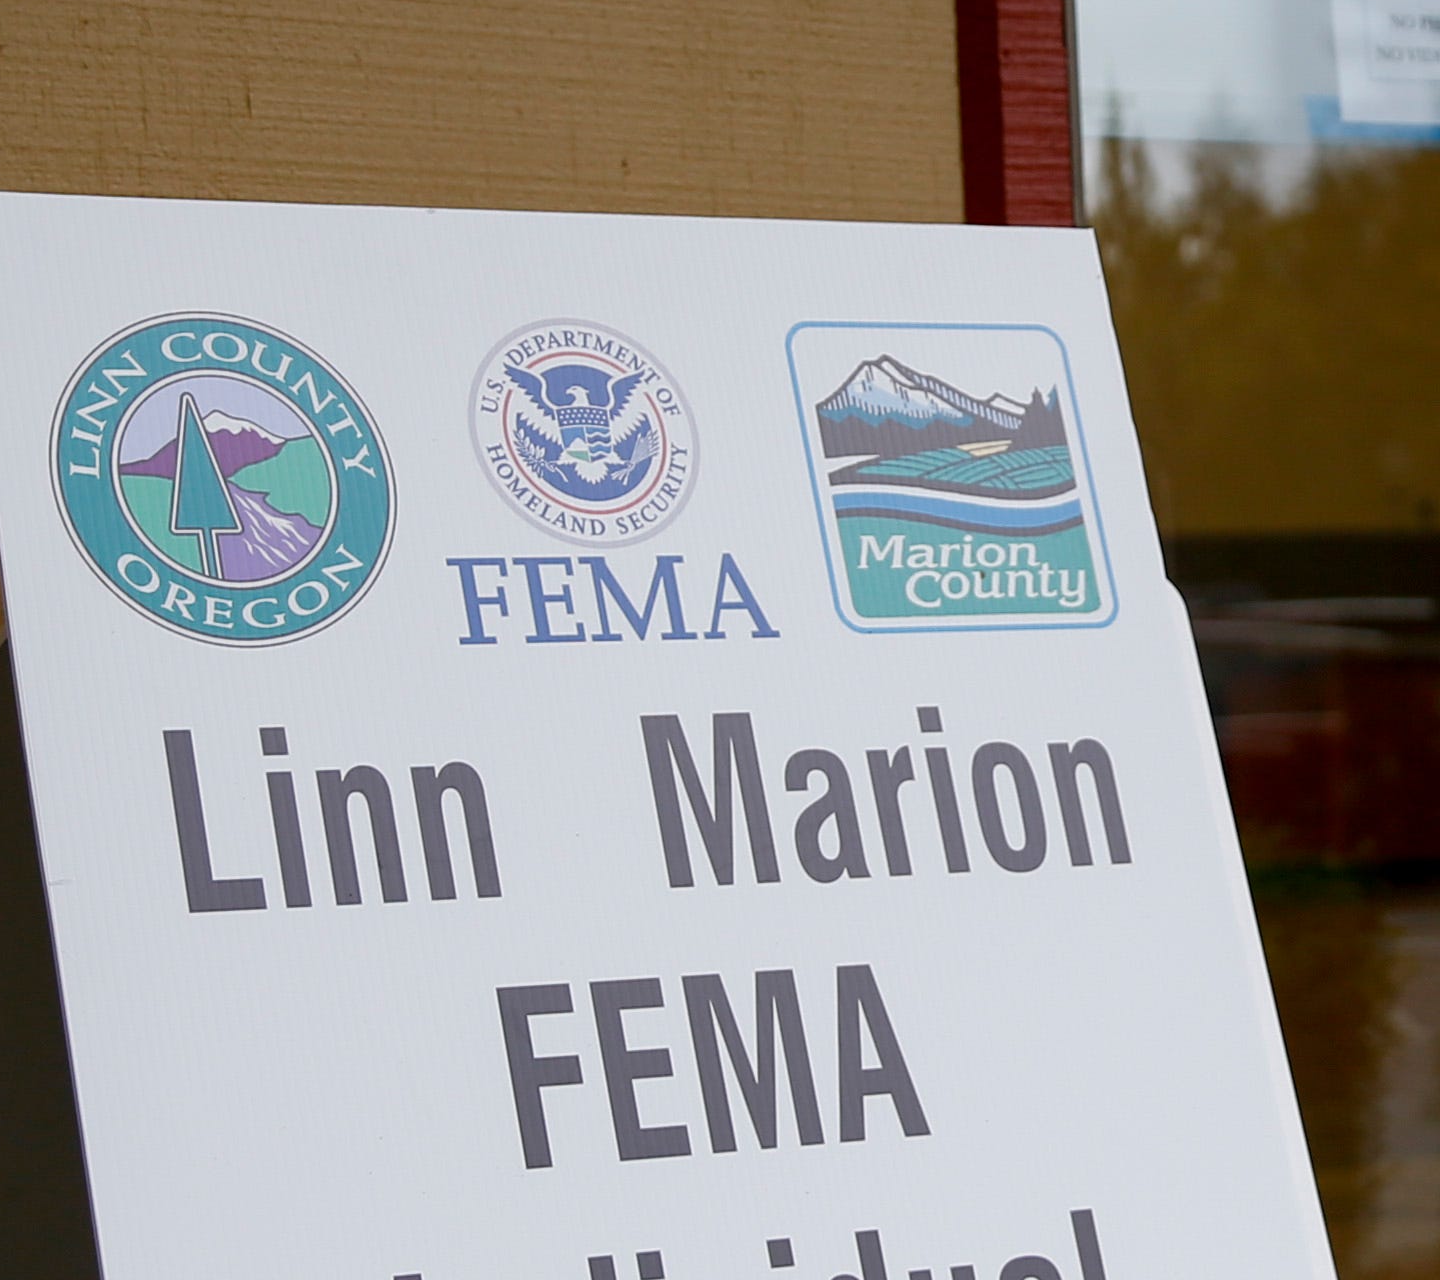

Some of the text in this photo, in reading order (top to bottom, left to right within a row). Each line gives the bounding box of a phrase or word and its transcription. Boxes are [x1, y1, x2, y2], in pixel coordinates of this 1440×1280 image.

[68, 331, 377, 481] LINN COUNTY
[480, 330, 682, 418] U.S. DEPARTMENT OF
[485, 442, 689, 537] HOMELAND SECURITY
[115, 543, 365, 630] OREGON
[857, 533, 1042, 570] Marion
[905, 561, 1087, 609] County
[445, 553, 781, 645] FEMA
[163, 706, 1132, 914] Linn Marion
[496, 964, 932, 1170] FEMA
